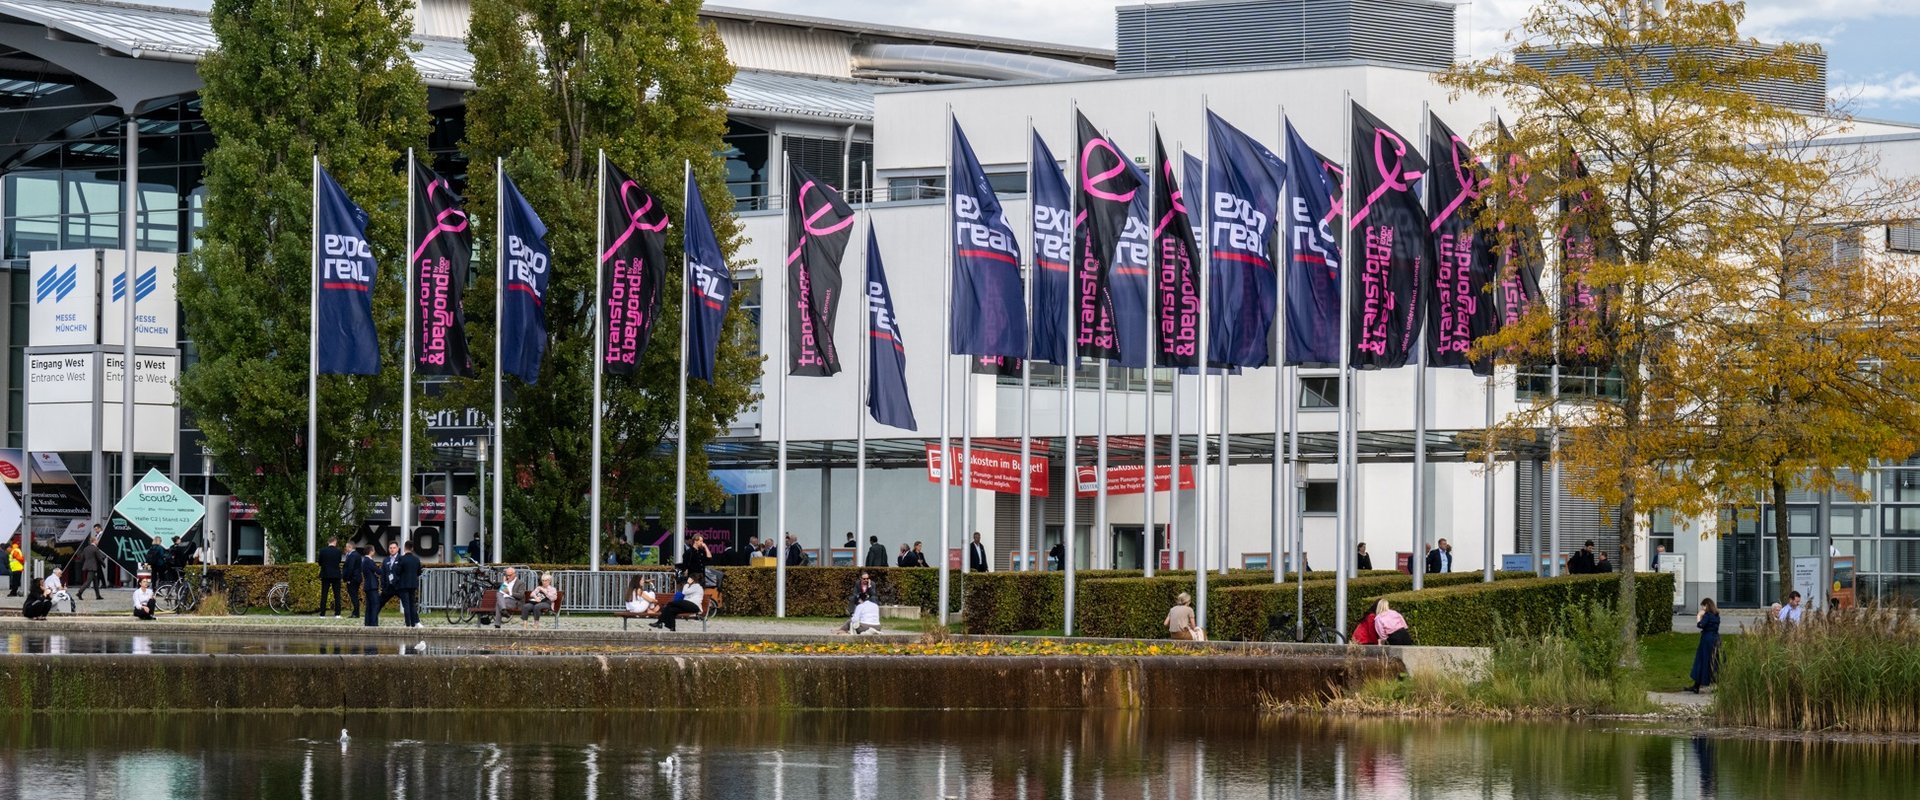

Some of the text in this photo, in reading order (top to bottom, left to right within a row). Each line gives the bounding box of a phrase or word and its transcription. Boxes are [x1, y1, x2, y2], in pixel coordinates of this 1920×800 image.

[1357, 225, 1380, 353] transform
[1436, 233, 1454, 355] transform
[1452, 252, 1477, 338] beyond
[55, 313, 77, 322] MESSE
[419, 258, 432, 364] transform
[605, 258, 627, 364] transform
[428, 273, 454, 365] & beyond
[621, 273, 644, 365] & beyond
[55, 323, 88, 333] MÜNCHEN
[31, 358, 85, 370] Eingang West
[106, 358, 166, 371] Eingg West
[31, 372, 86, 383] Entrance West
[106, 371, 168, 384] Entrce West
[1000, 458, 1010, 469] im
[139, 493, 178, 503] Scout24
